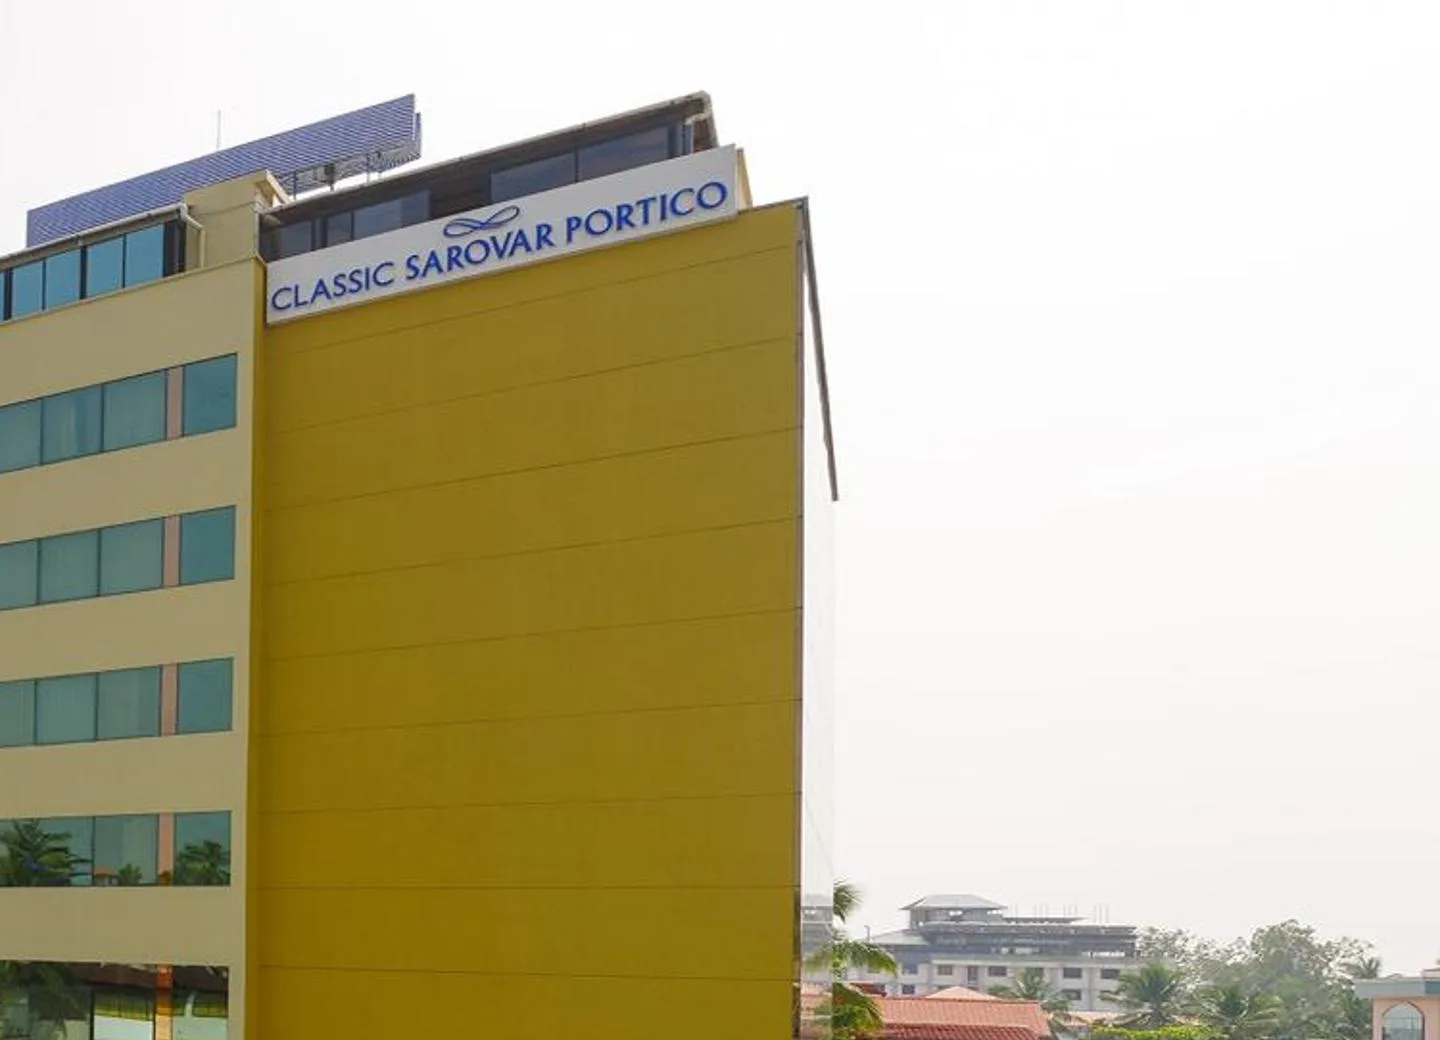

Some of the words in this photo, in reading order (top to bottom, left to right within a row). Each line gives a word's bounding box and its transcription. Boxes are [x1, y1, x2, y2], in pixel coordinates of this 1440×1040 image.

[271, 262, 395, 310] CLASSIC
[406, 223, 556, 280] SAROVAR
[565, 181, 728, 244] PORTICO
